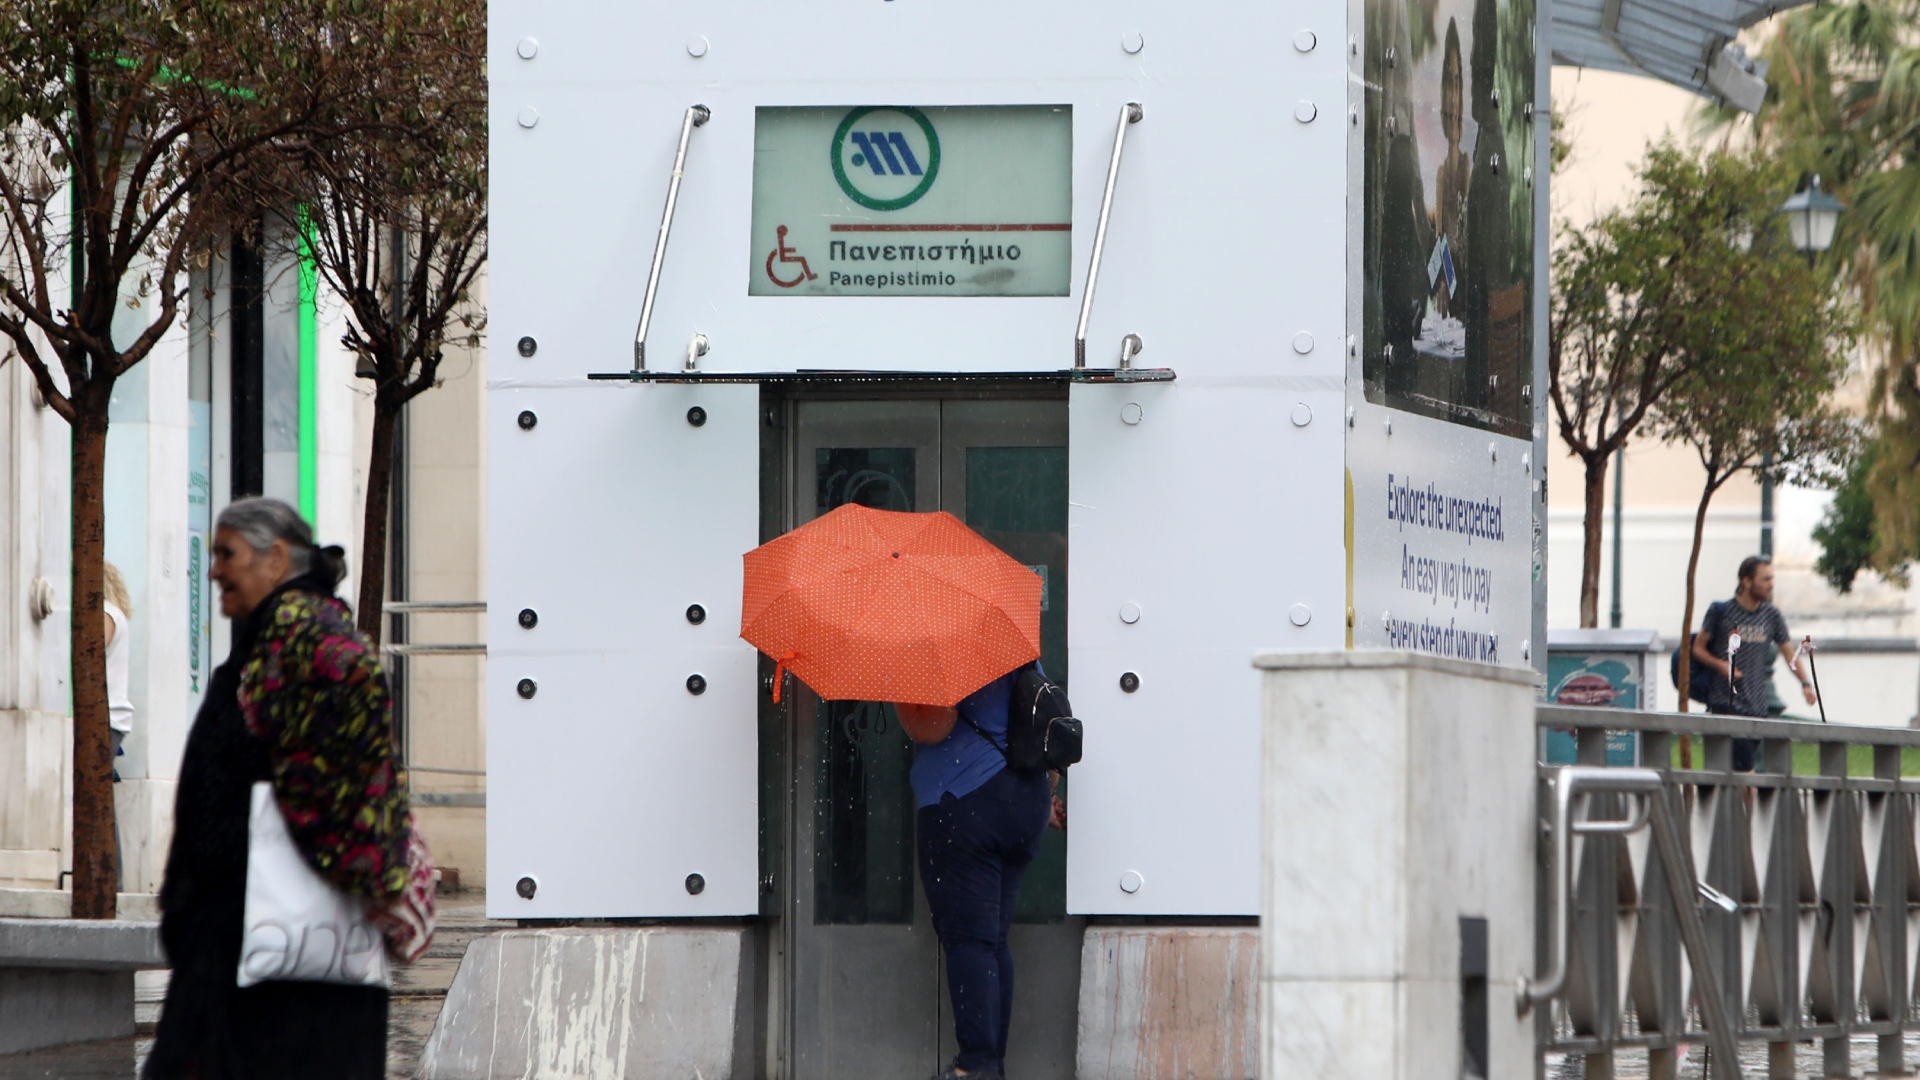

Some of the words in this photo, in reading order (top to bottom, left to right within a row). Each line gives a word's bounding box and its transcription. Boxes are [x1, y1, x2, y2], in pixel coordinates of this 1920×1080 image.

[829, 238, 1021, 265] Πανεπιστήμιο
[829, 271, 956, 288] Panepistimio
[1388, 473, 1426, 532] Explore
[1427, 481, 1444, 531] the
[1445, 495, 1504, 546] unexpected.
[1401, 543, 1415, 591] An
[1417, 556, 1440, 606] easy
[1441, 561, 1461, 609] way
[1462, 557, 1473, 601] to
[1474, 566, 1492, 614] pay
[1390, 618, 1419, 650] every
[1420, 617, 1442, 655] step
[1444, 617, 1455, 657] of
[1456, 630, 1478, 661] your
